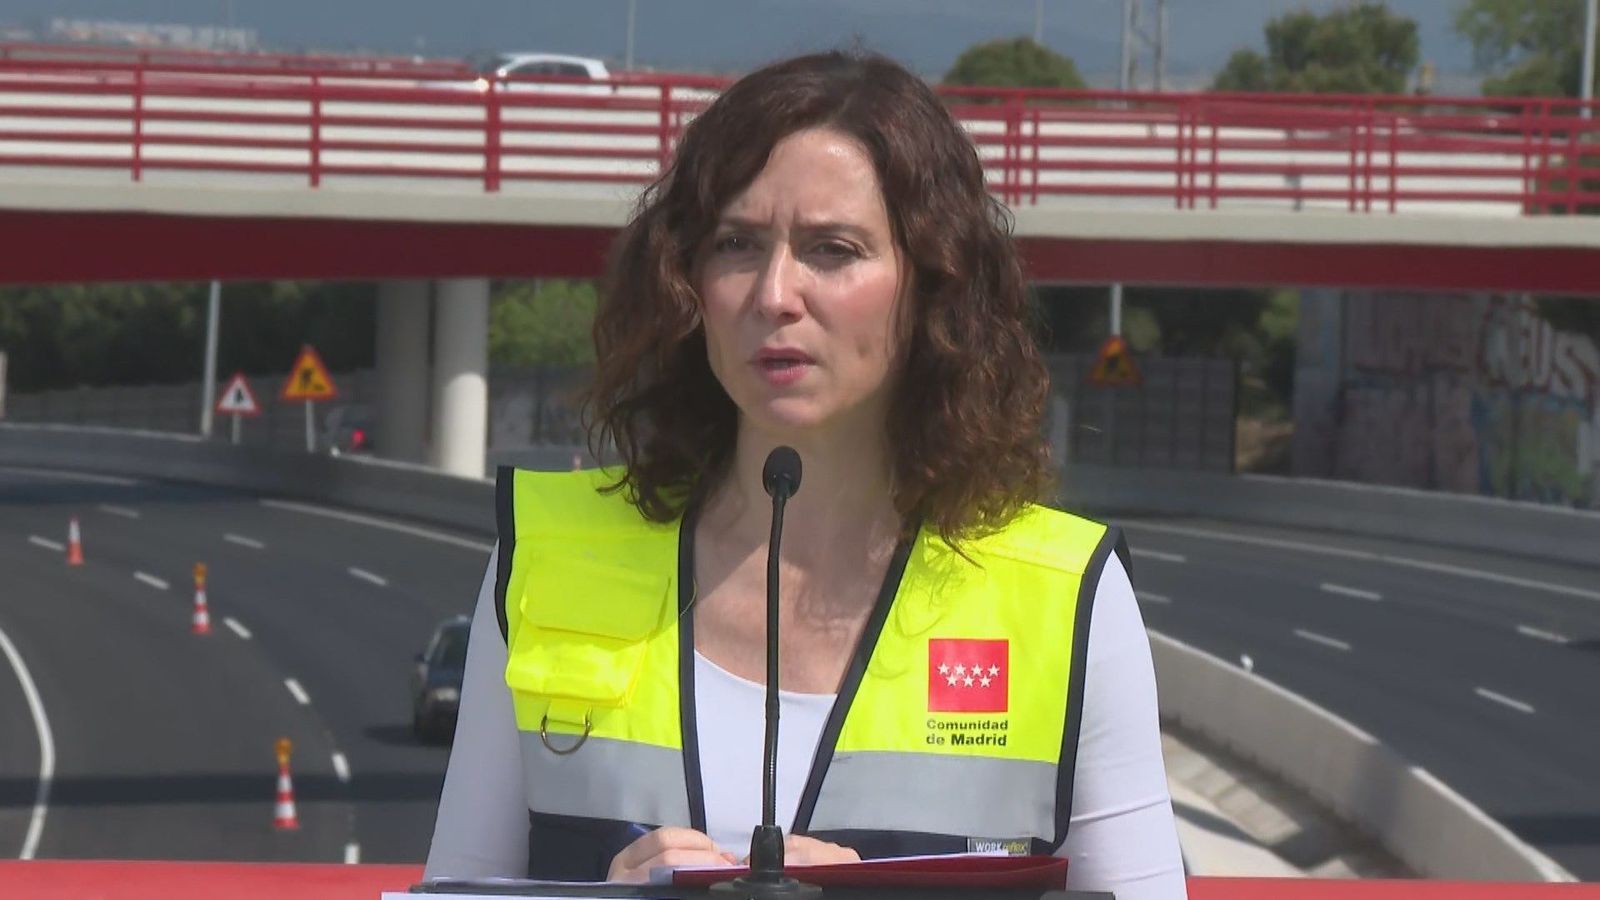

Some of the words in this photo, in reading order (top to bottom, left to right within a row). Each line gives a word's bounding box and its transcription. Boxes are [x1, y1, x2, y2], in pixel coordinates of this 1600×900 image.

[926, 719, 1008, 730] Comunidad
[926, 733, 945, 745] de
[951, 733, 1007, 746] Madrid
